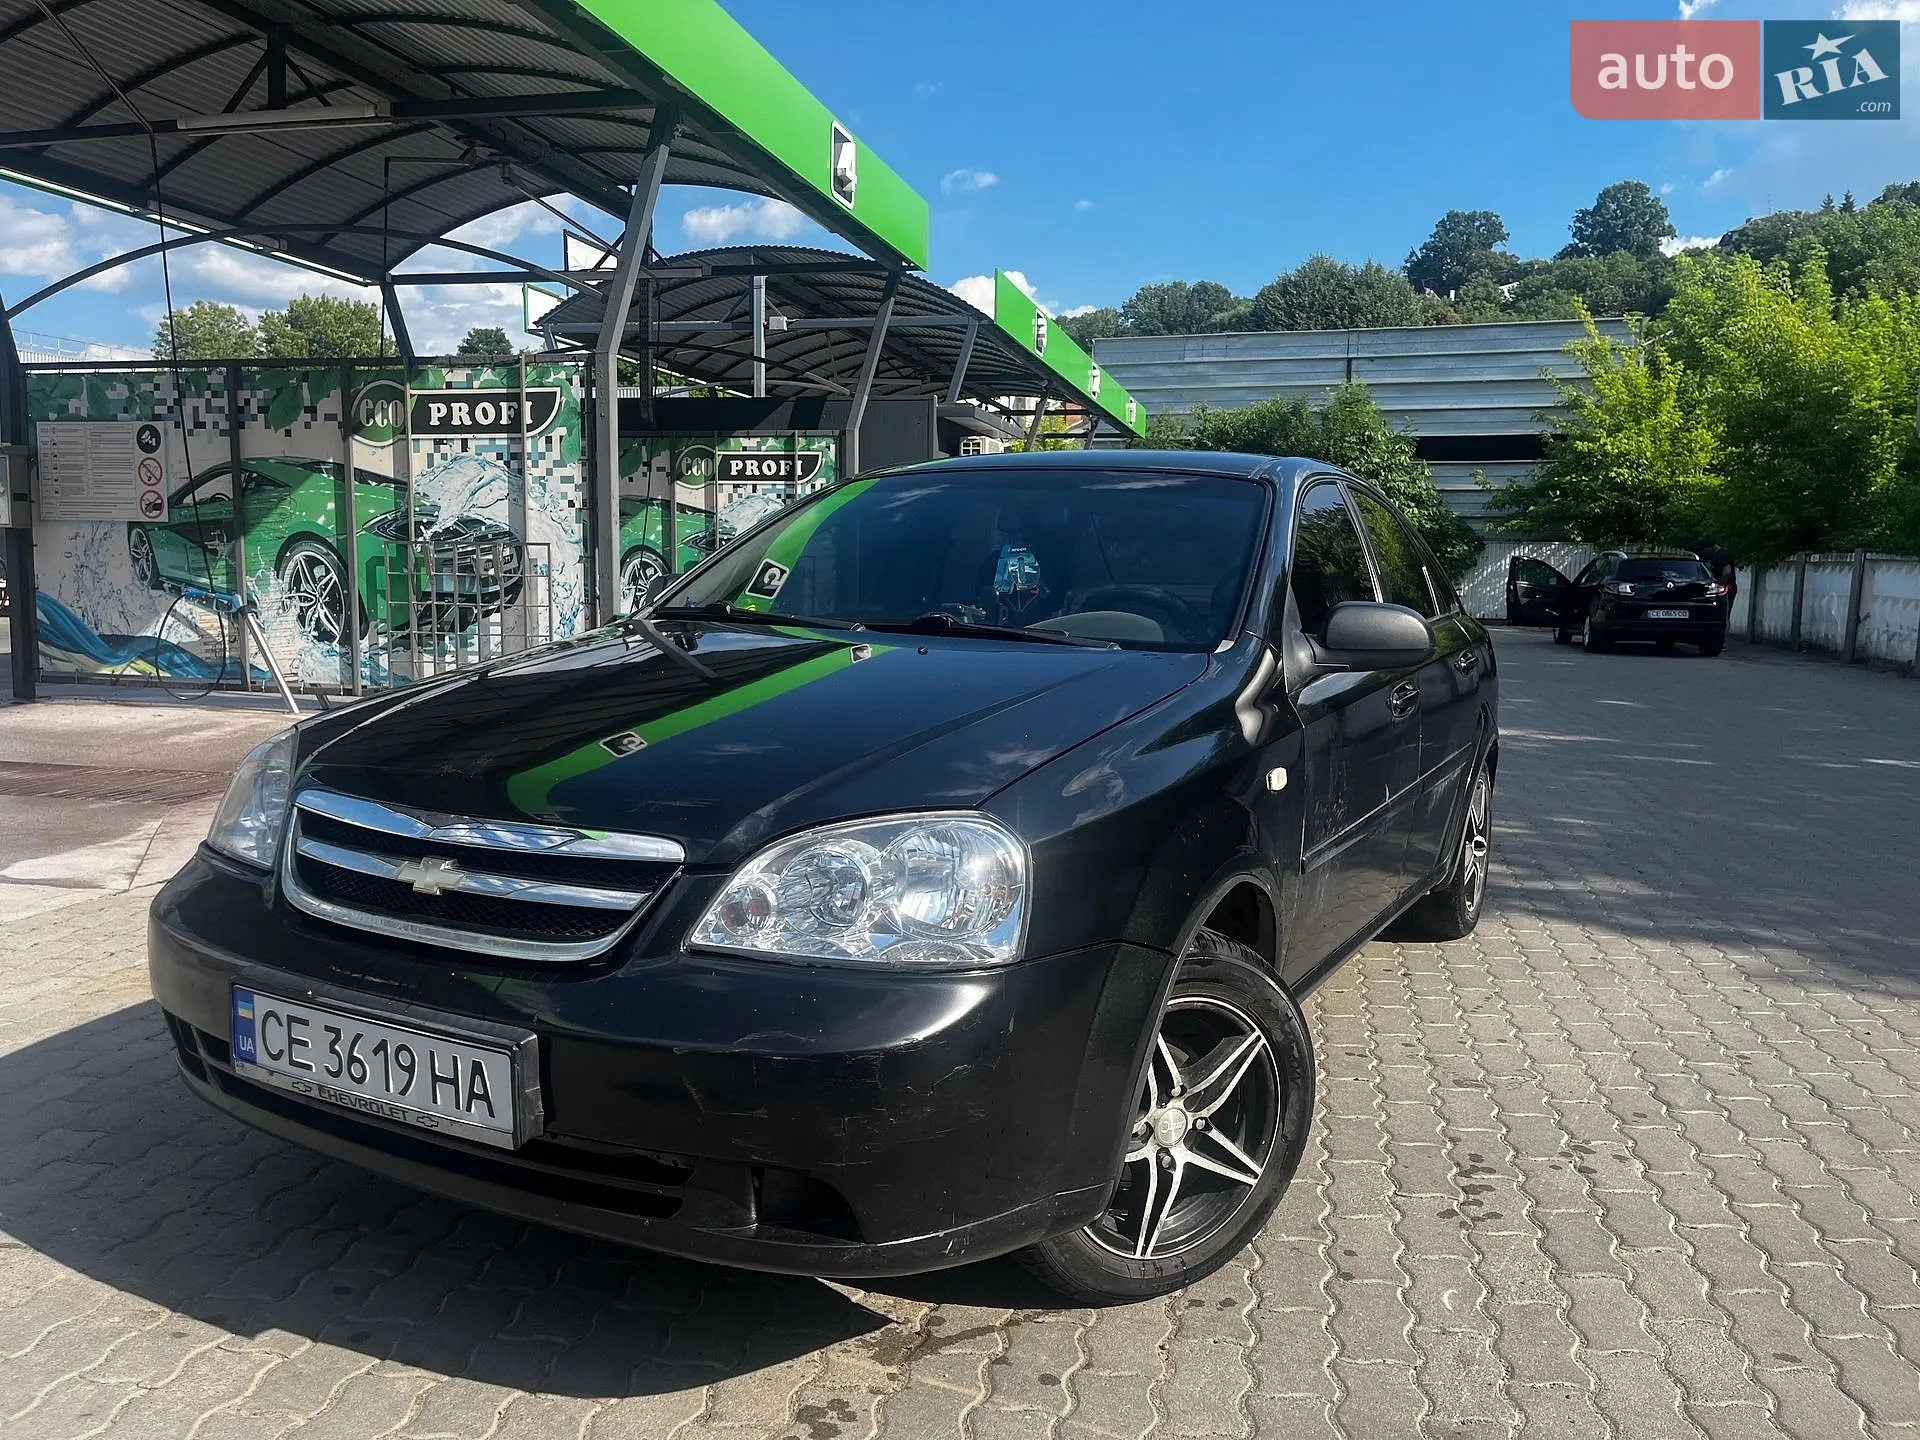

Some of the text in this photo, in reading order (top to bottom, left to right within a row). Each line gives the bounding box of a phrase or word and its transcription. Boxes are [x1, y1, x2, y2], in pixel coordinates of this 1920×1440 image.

[360, 399, 533, 427] eco PROFI
[681, 457, 803, 476] eco PROFI
[239, 1034, 255, 1054] UA
[260, 1009, 495, 1118] CE 3619 HA
